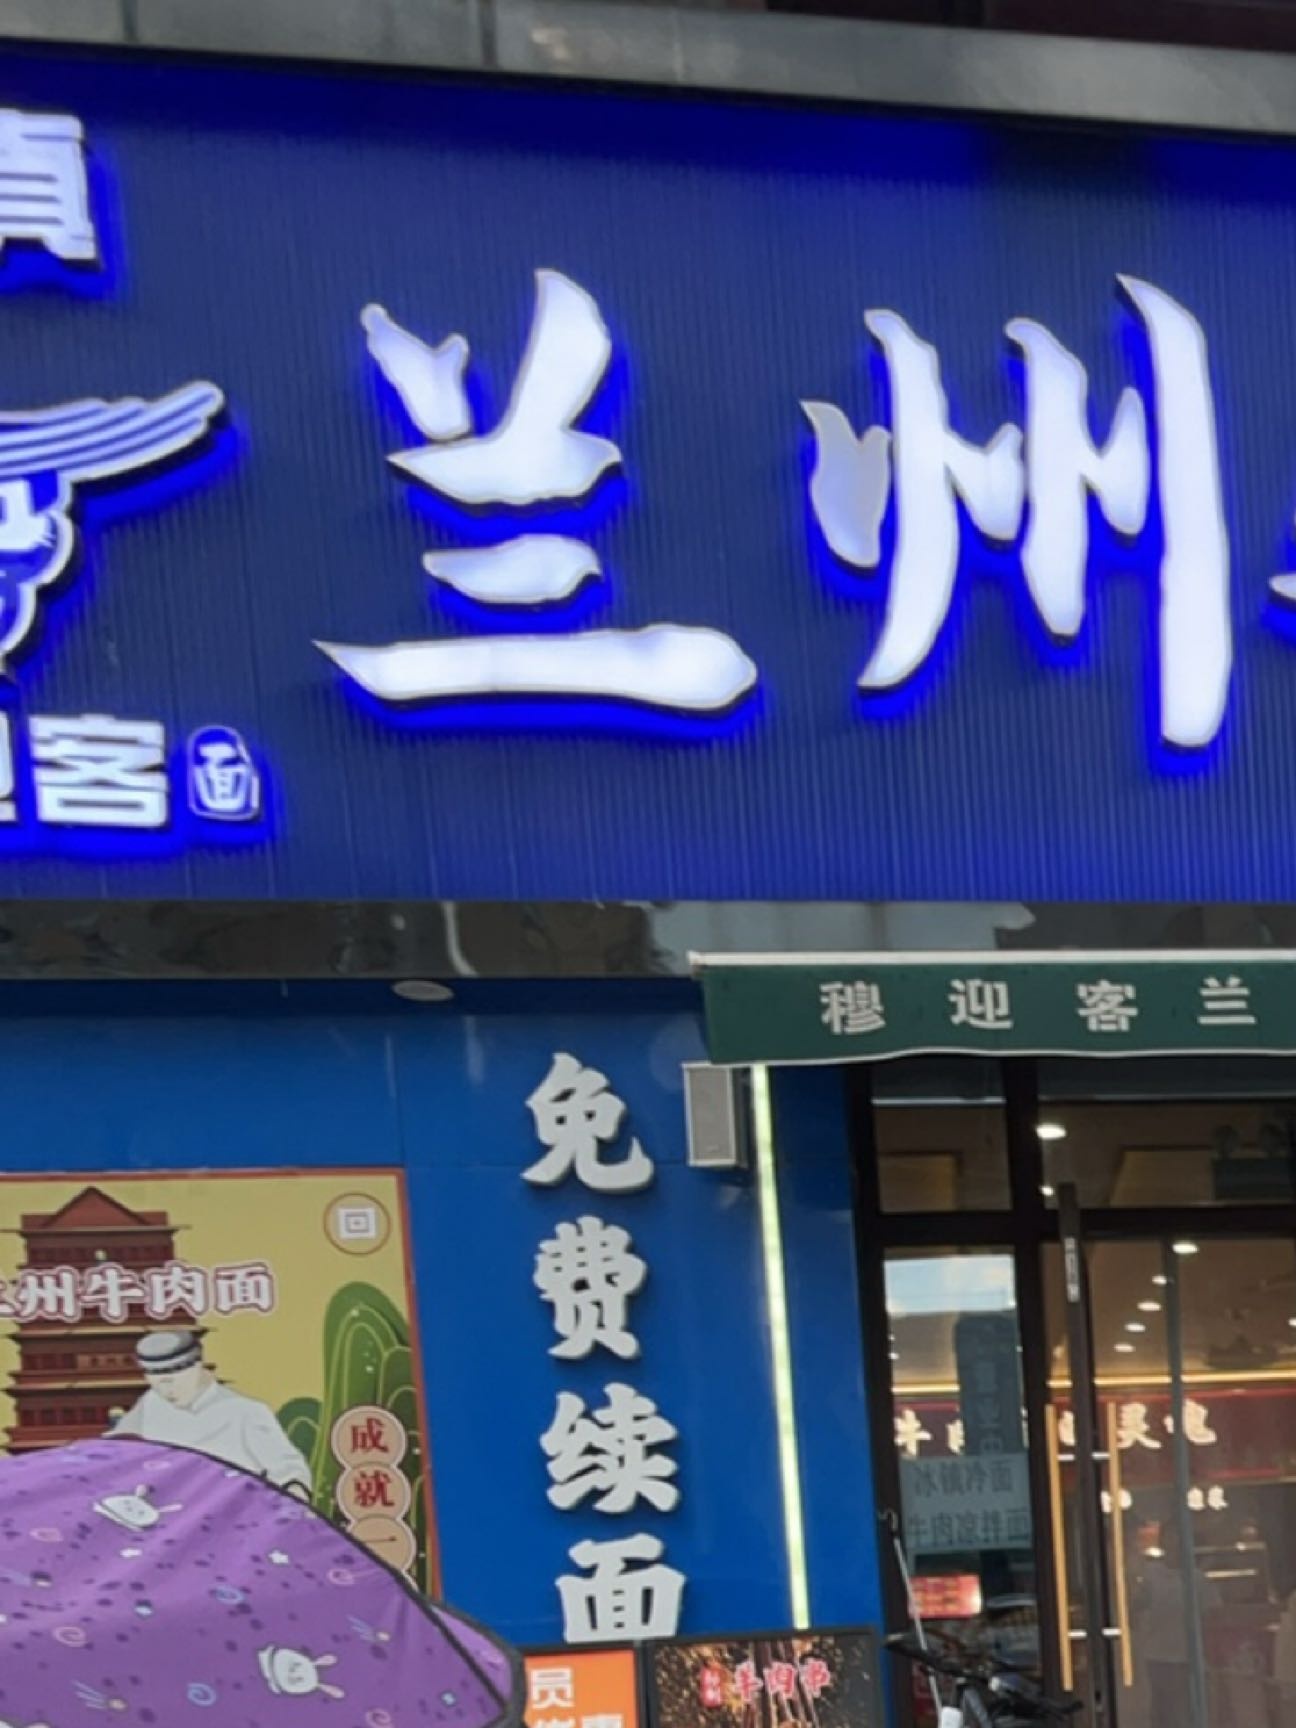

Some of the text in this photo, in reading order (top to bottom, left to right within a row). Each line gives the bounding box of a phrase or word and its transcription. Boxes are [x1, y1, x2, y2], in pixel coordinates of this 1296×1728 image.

[0, 1262, 276, 1320] 州牛肉面
[520, 1052, 687, 1644] 免费续面
